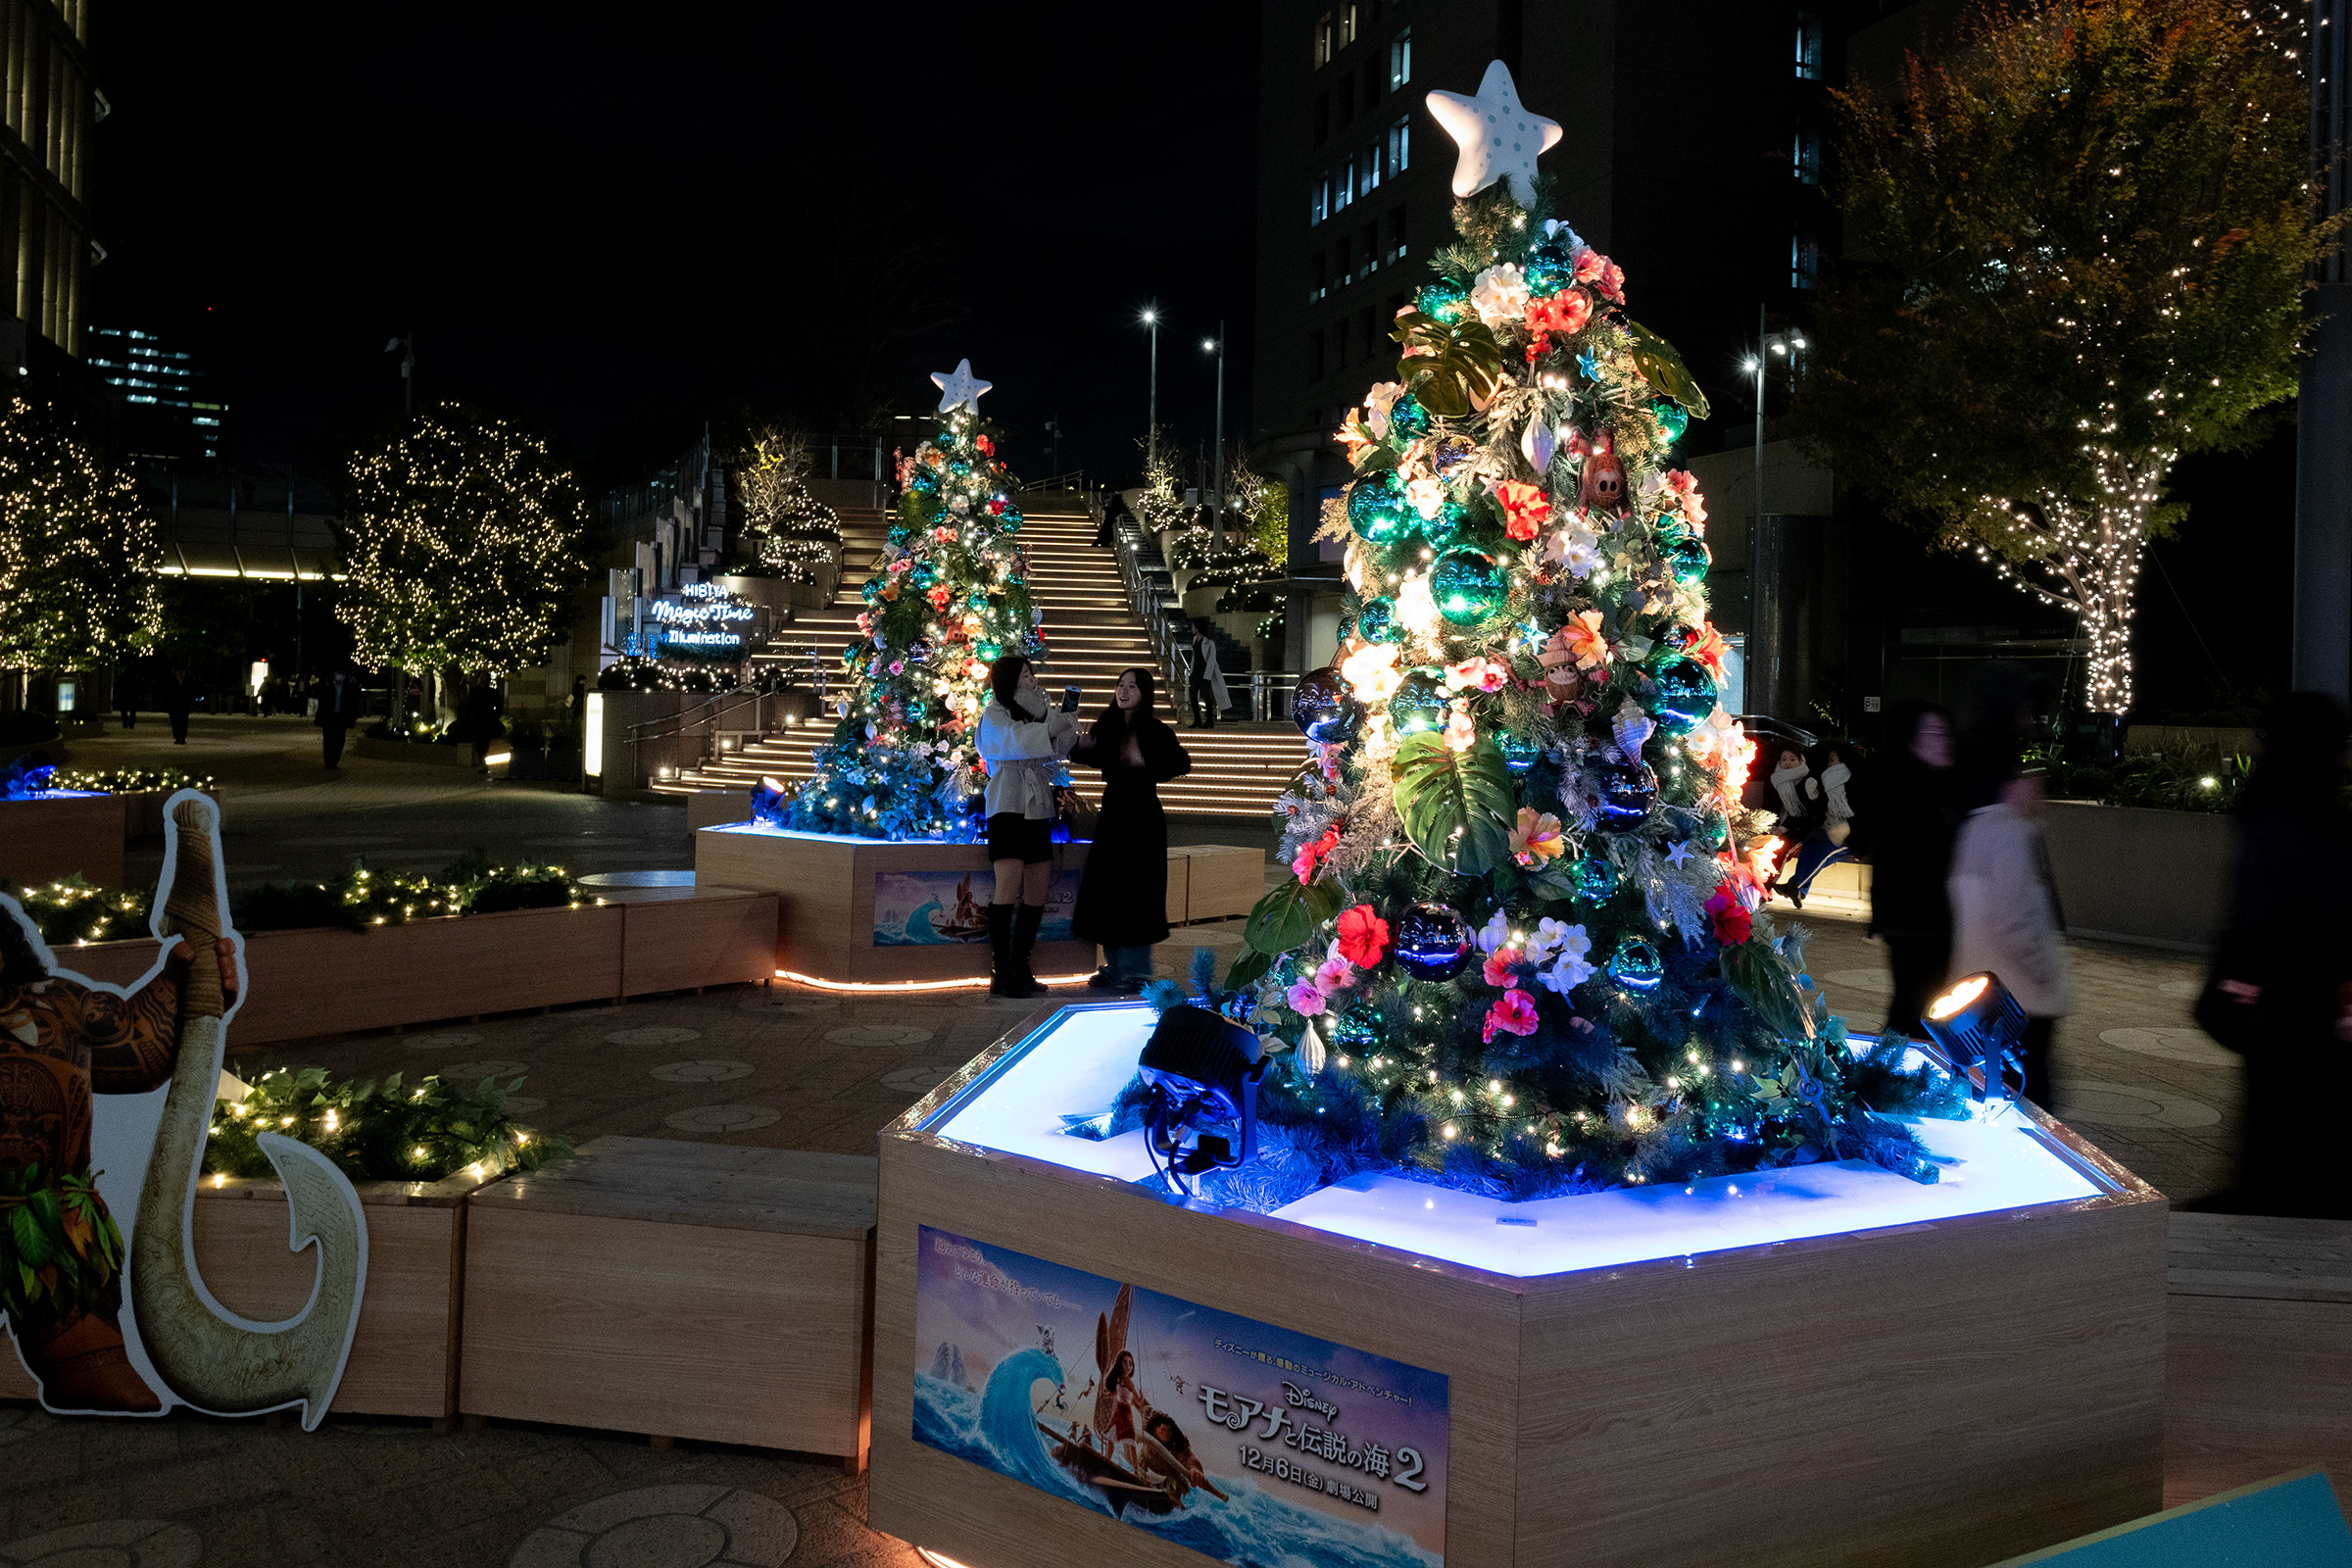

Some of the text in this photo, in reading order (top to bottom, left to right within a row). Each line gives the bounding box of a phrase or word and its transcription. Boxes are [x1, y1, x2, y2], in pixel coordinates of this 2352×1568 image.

[684, 584, 728, 598] HIBIYA
[652, 601, 754, 624] Magic Time
[668, 630, 741, 646] Illumination
